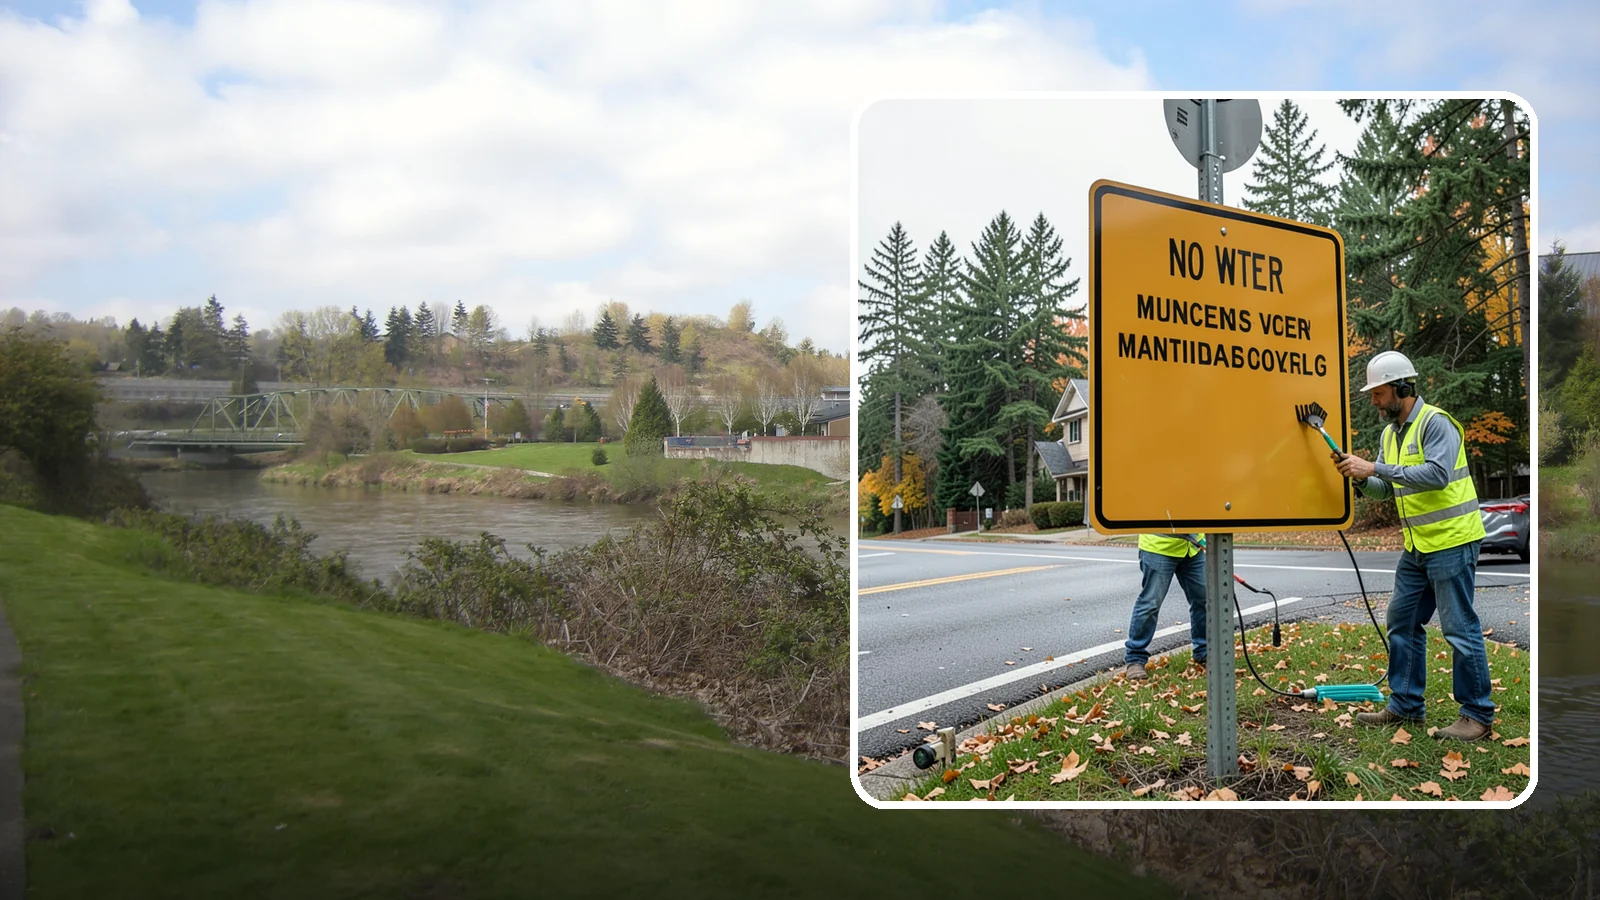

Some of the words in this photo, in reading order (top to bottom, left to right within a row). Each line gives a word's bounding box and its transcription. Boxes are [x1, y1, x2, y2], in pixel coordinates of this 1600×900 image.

[1169, 238, 1204, 281] NO
[1215, 245, 1284, 294] WTER
[1137, 294, 1251, 333] MUNCENS
